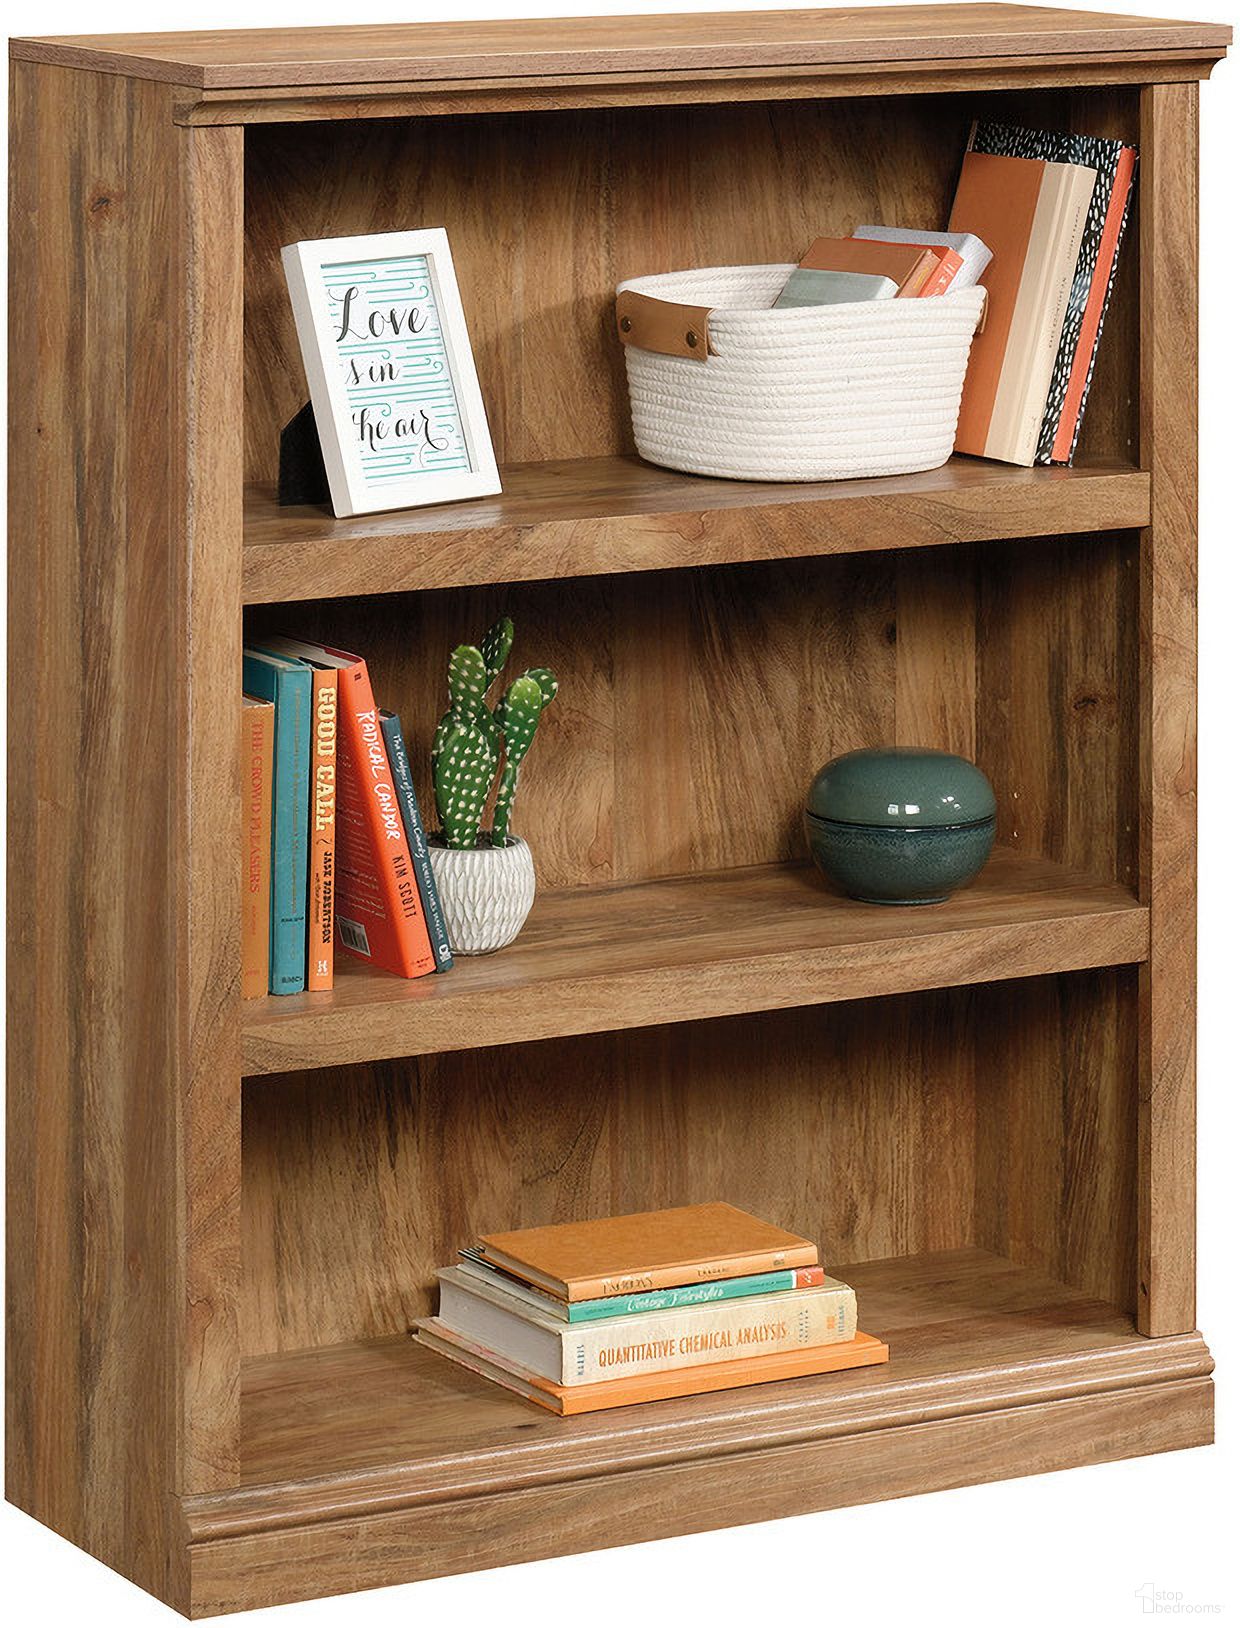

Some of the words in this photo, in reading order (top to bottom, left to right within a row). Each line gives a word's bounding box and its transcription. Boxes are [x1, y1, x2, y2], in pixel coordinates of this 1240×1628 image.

[328, 286, 428, 342] Love
[352, 407, 389, 452] he
[395, 409, 449, 467] air
[251, 721, 264, 752] THE
[316, 686, 337, 757] GOOD
[393, 734, 402, 750] The
[250, 755, 263, 813] CROWD
[315, 764, 335, 831] CALL
[356, 709, 385, 779] RADICAL
[373, 783, 401, 840] CANDOR
[249, 816, 263, 894] PLEASERS
[392, 854, 409, 879] KIM
[322, 880, 332, 944] ROBERTSON
[398, 881, 417, 918] SCOTT
[599, 1338, 675, 1368] QUANTITATIVE
[678, 1330, 733, 1355] CHEMICAL
[735, 1321, 788, 1346] ANALYSIS
